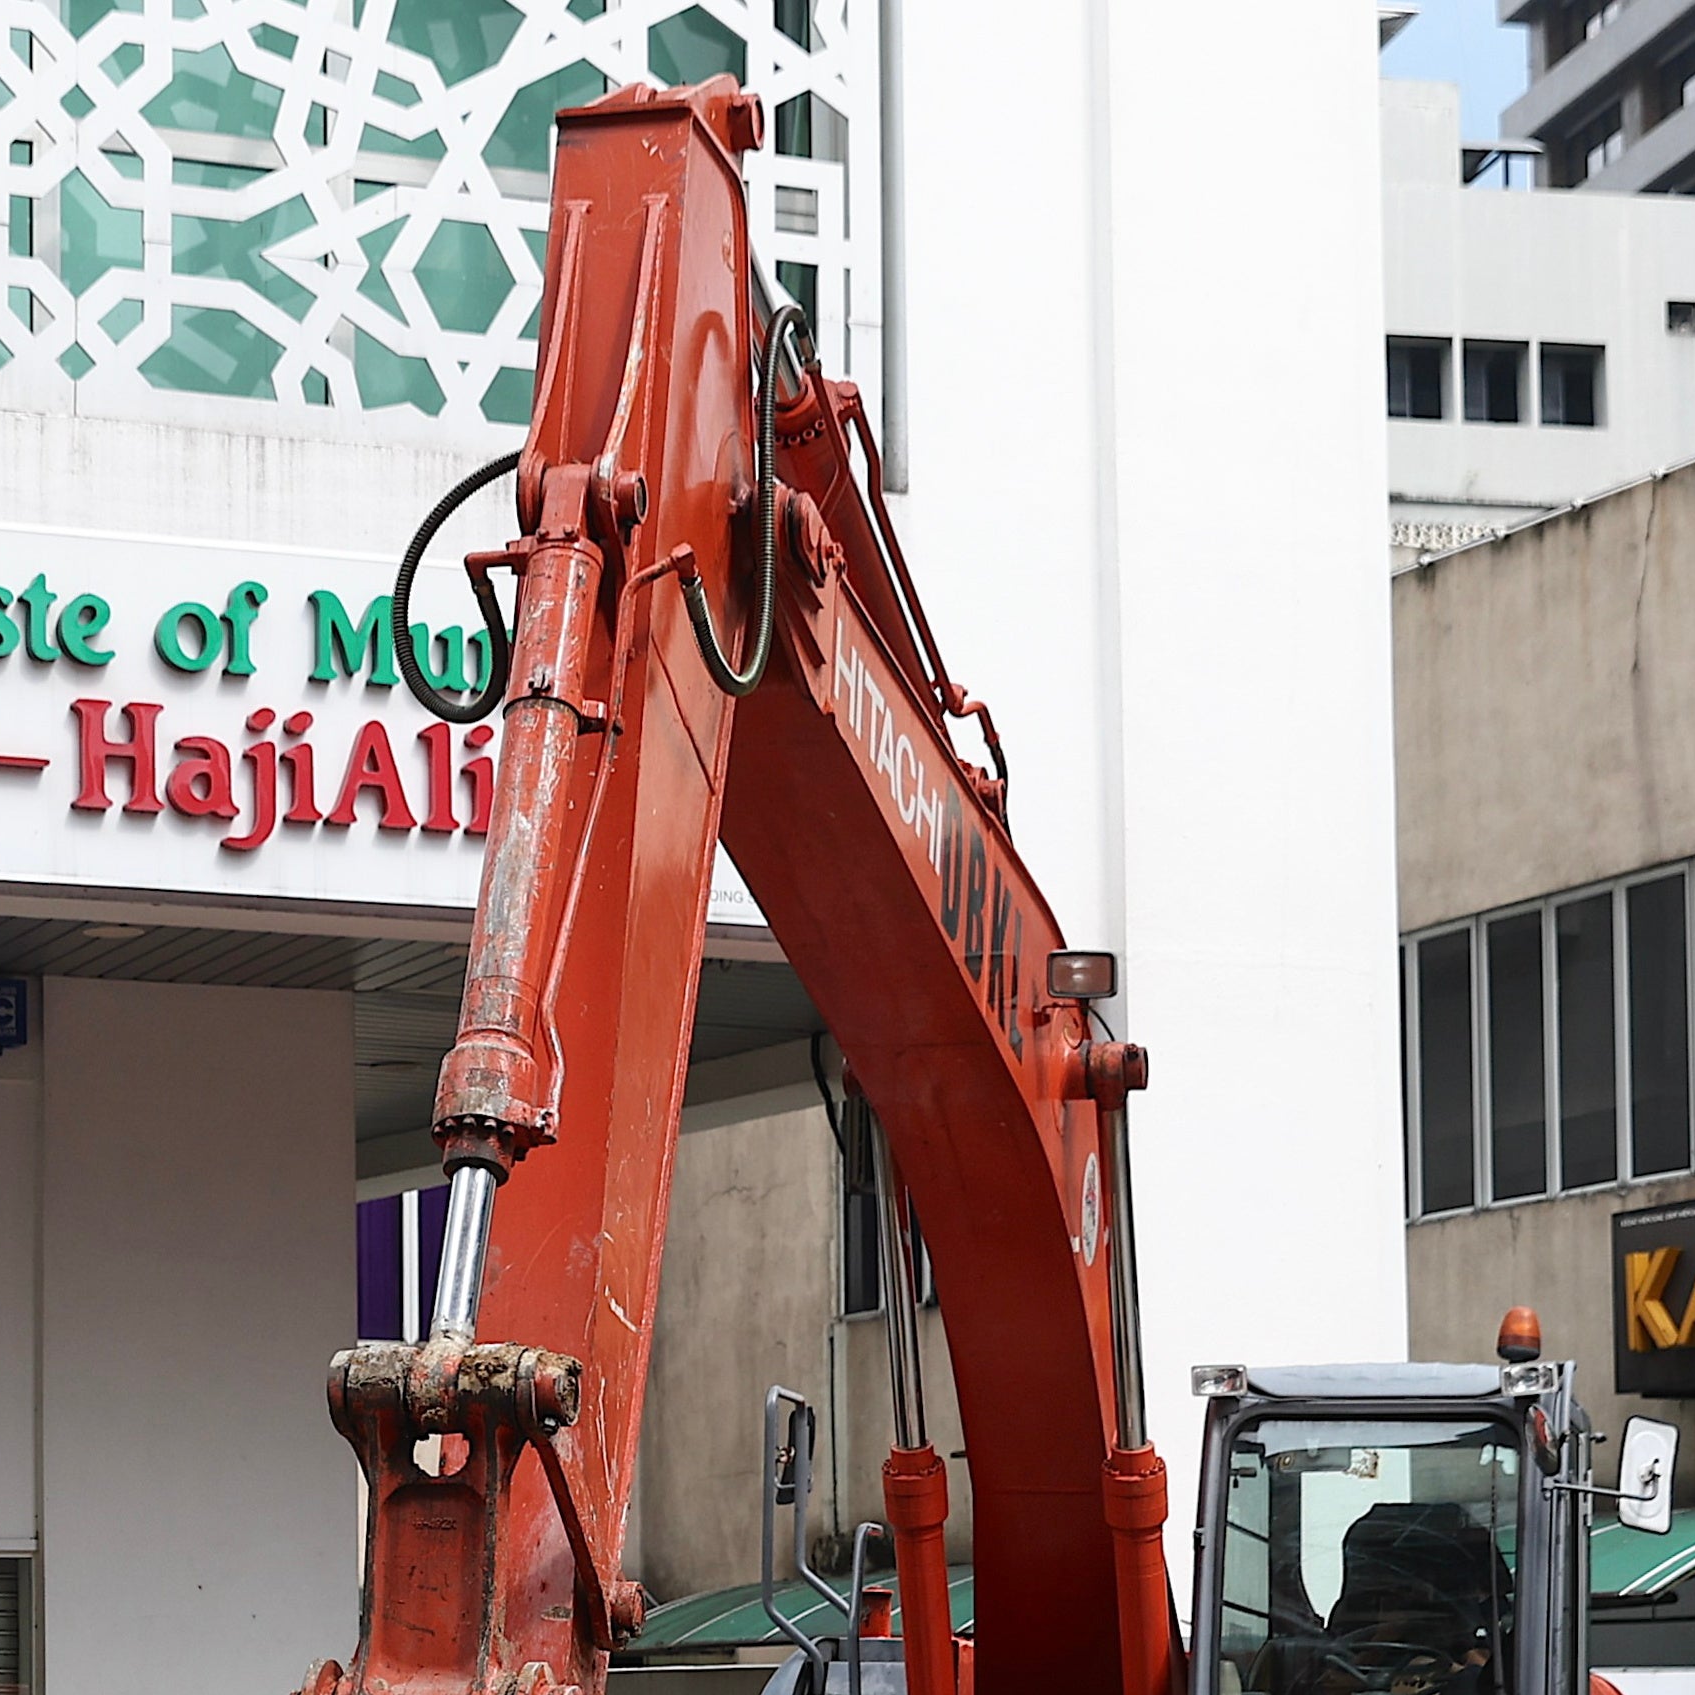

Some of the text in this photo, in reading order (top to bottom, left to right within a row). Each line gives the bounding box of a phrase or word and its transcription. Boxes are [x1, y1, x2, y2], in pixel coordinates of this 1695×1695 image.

[154, 580, 268, 676] of
[834, 617, 942, 875] HITACHI
[940, 776, 1023, 1066] DBKL
